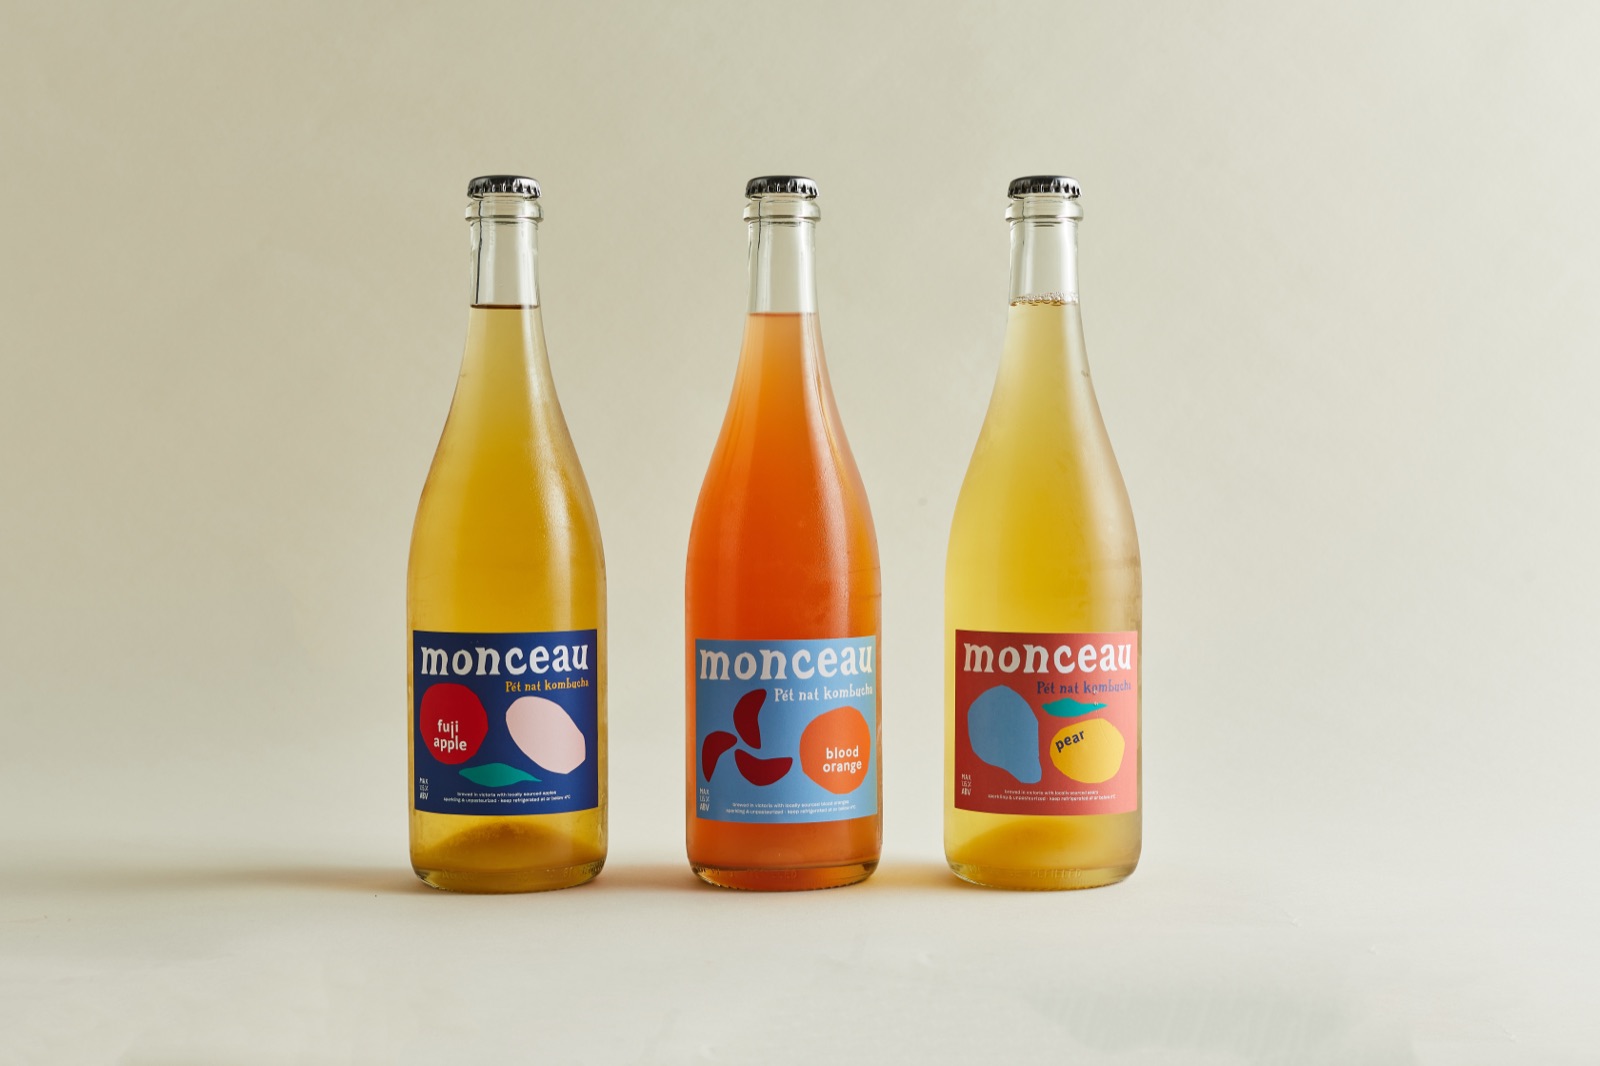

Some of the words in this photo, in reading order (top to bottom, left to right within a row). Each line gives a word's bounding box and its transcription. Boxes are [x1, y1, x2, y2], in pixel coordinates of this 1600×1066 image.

[420, 644, 589, 676] monceau
[699, 646, 873, 681] monceau
[963, 643, 1132, 674] monceau
[505, 680, 521, 692] Pét
[524, 681, 541, 692] nat
[545, 677, 589, 691] kombucha
[774, 688, 794, 702] Pét
[798, 687, 819, 701] nat
[823, 683, 873, 700] kombucha
[1036, 681, 1055, 695] Pét
[1059, 681, 1079, 694] nat
[1083, 679, 1132, 694] kombucha
[437, 719, 459, 738] fuji
[433, 736, 467, 753] apple
[1055, 730, 1085, 753] pear
[826, 745, 859, 760] blood
[822, 759, 862, 774] orange
